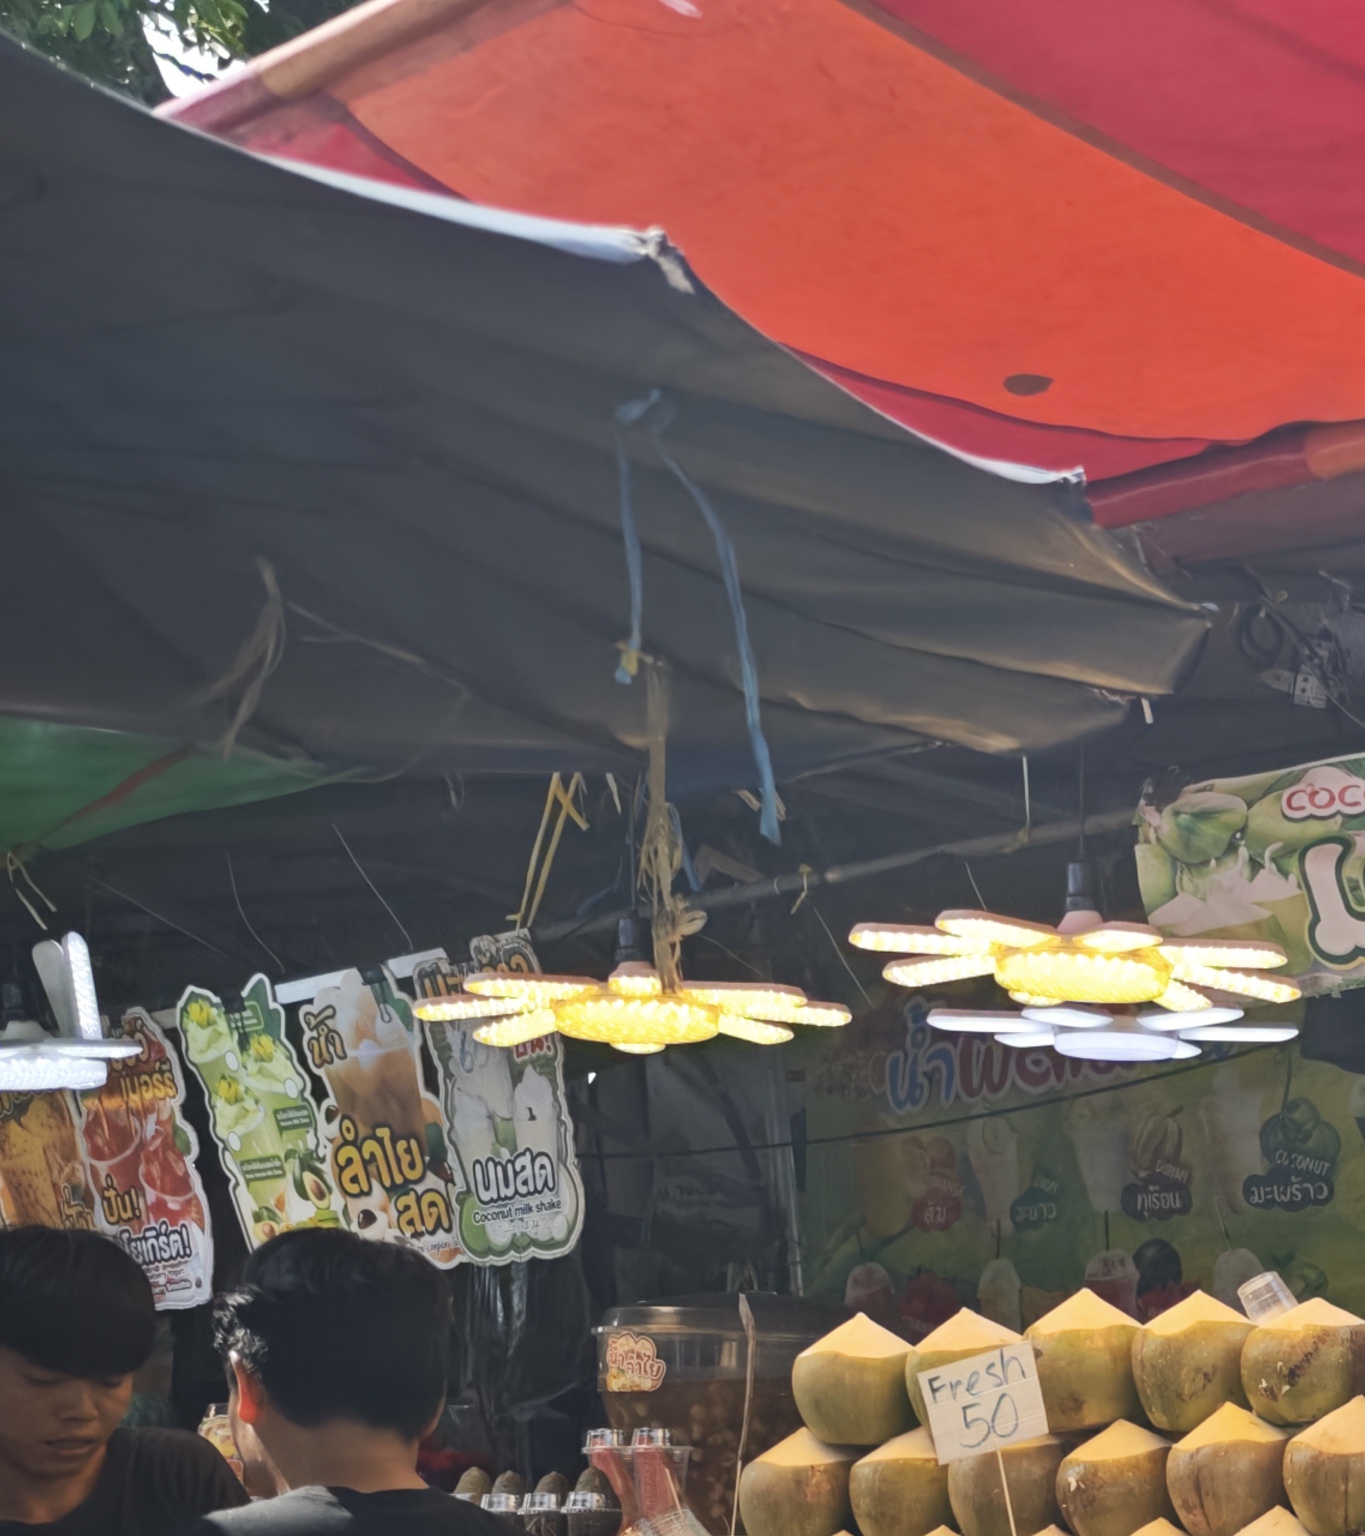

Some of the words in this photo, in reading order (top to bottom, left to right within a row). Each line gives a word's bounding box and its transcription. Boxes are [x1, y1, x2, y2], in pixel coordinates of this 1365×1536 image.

[304, 1005, 348, 1068] น้ำ
[335, 1115, 427, 1196] ลำไย
[474, 1150, 554, 1204] นมสด
[395, 1189, 452, 1236] สด
[473, 1208, 513, 1224] Coconut
[514, 1202, 534, 1216] milk
[535, 1199, 562, 1213] shake
[1249, 1176, 1329, 1204] มะพร้าว
[928, 1348, 1027, 1404] Fresh
[960, 1393, 1019, 1448] 50
